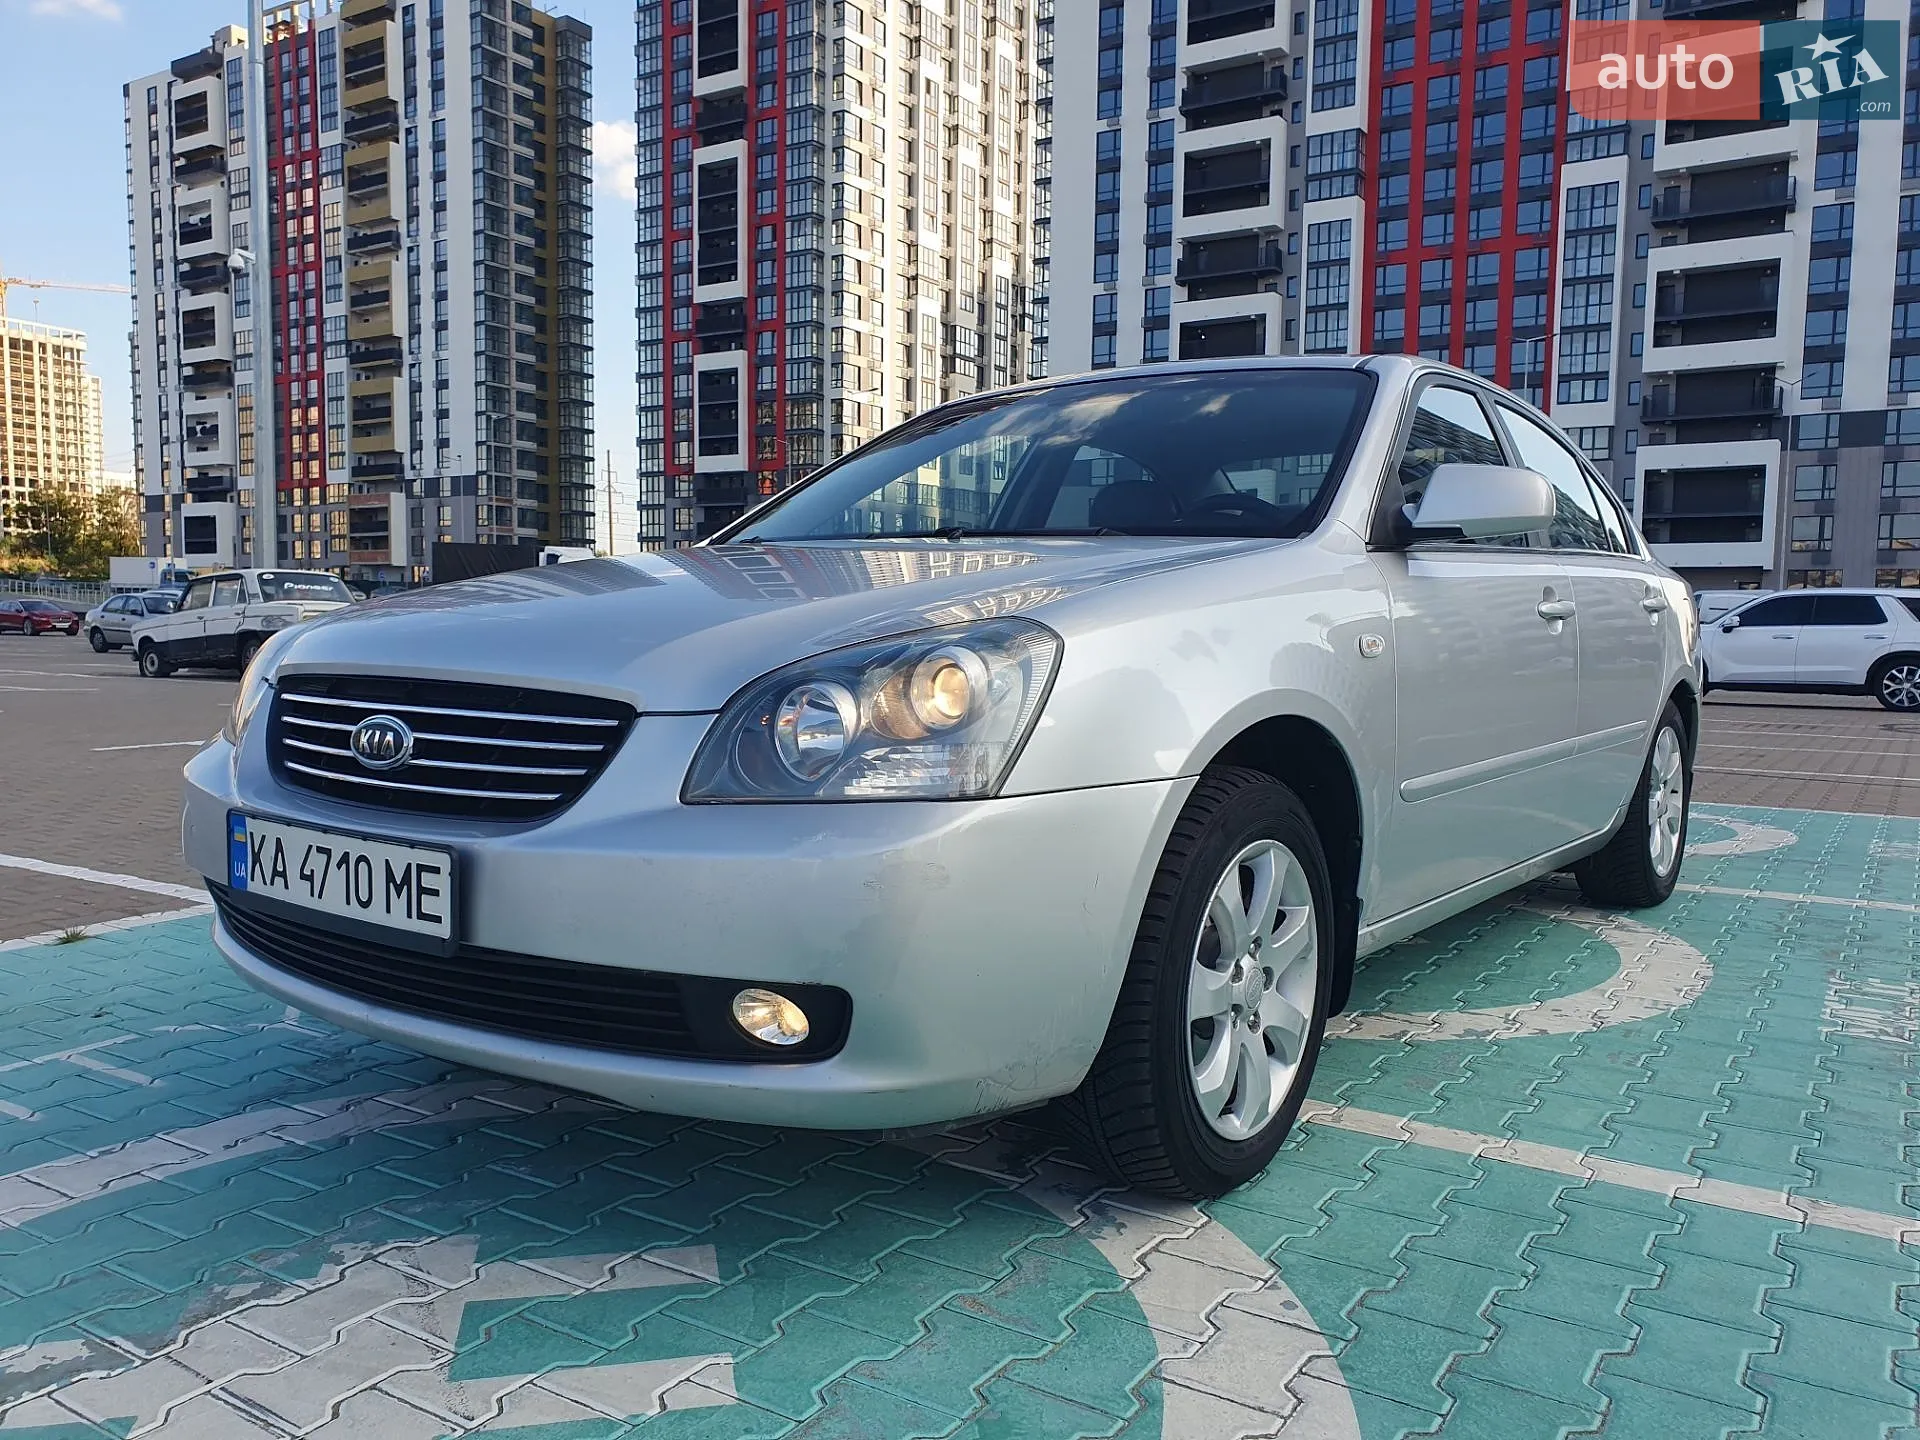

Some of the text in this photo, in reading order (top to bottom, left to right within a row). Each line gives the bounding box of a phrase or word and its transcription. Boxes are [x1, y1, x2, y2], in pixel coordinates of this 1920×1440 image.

[284, 582, 334, 591] Pioneer
[358, 728, 396, 756] KIA
[234, 861, 247, 878] UA
[249, 831, 443, 925] KA 4710 ME
